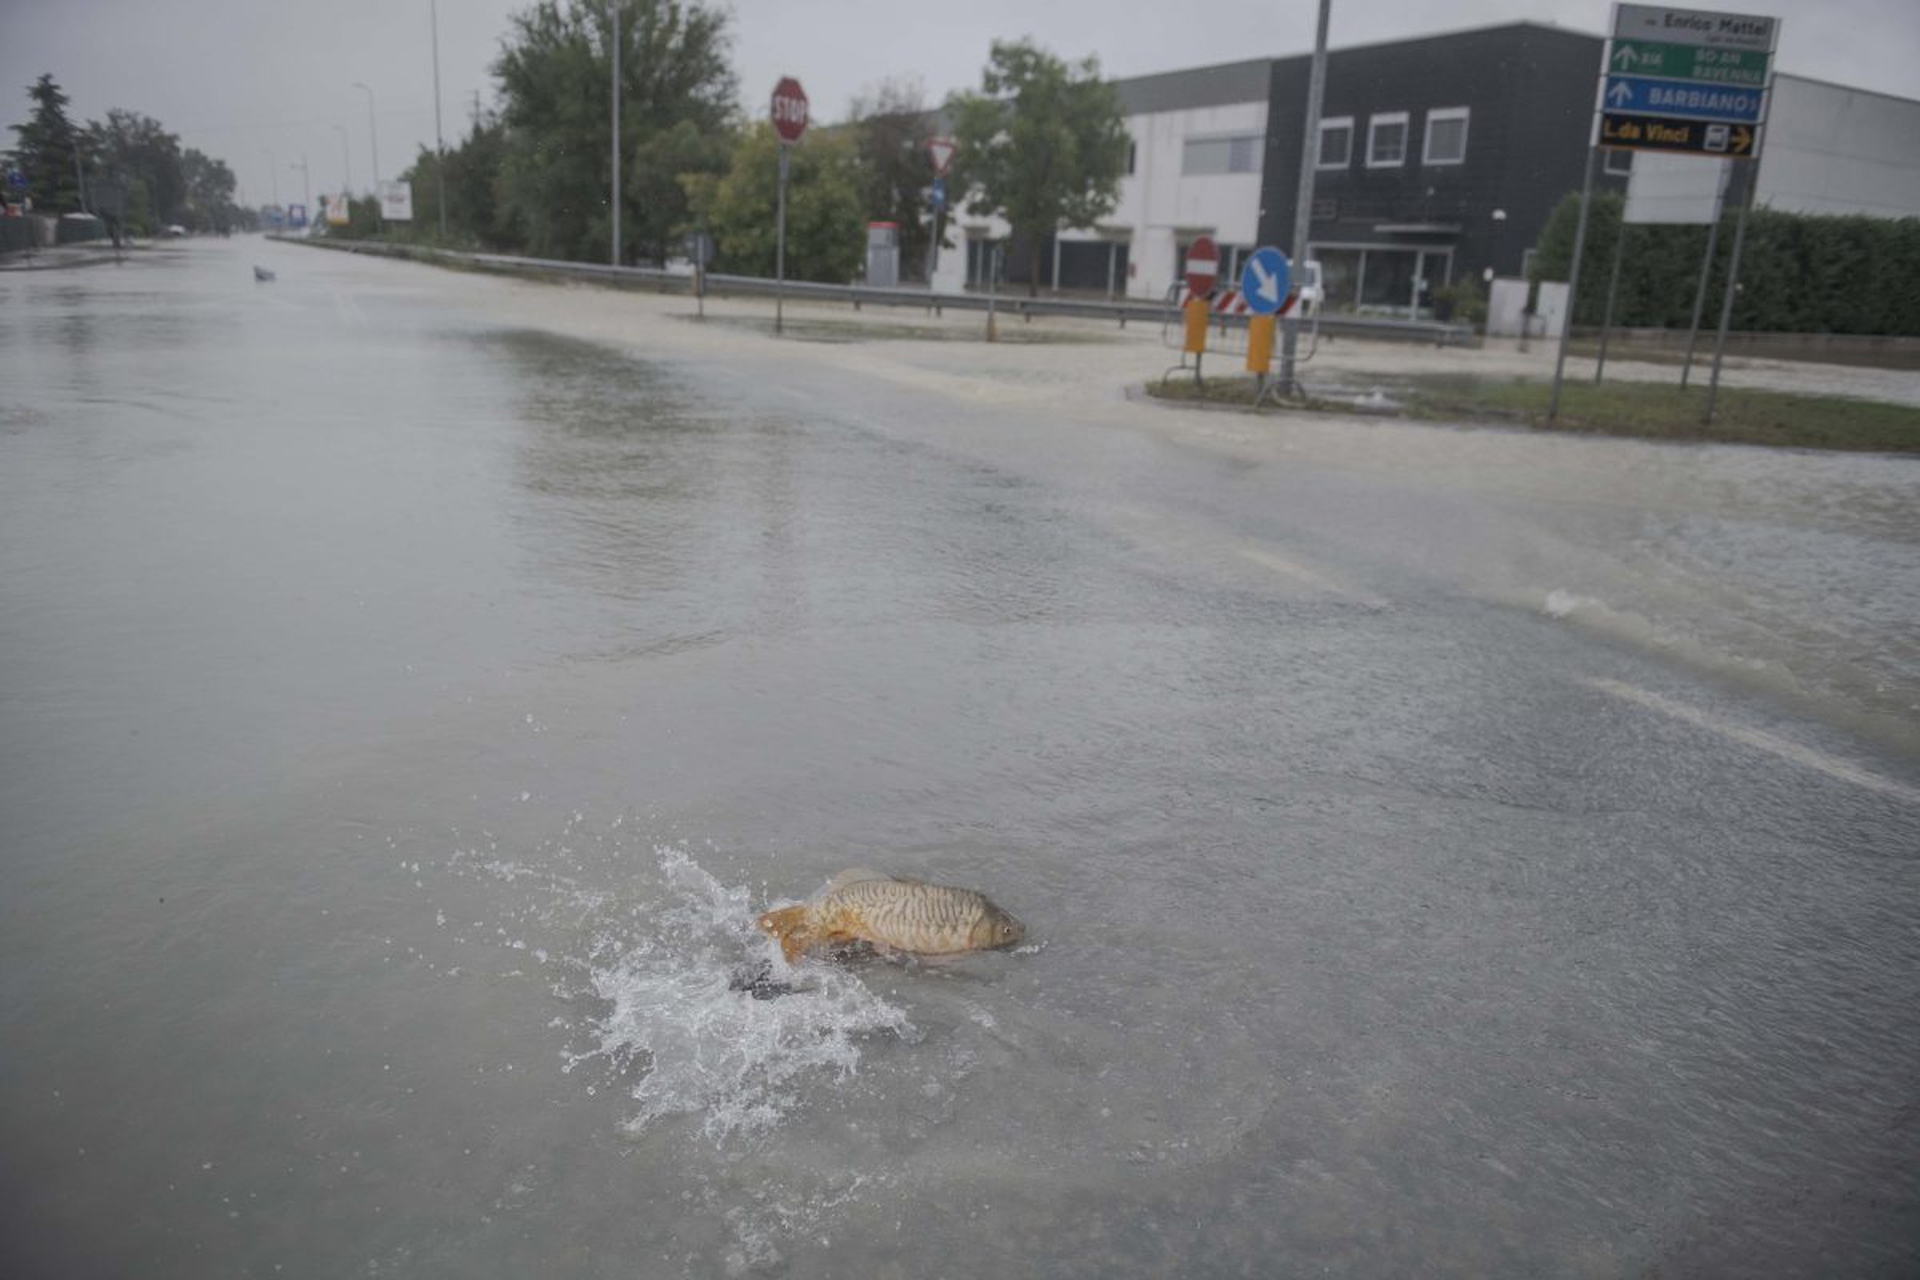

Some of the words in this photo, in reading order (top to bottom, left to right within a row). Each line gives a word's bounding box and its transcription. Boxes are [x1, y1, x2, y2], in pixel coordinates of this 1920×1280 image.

[1664, 13, 1712, 31] Enrico
[774, 96, 806, 123] STOP
[1648, 87, 1748, 112] BARBIANO
[1645, 122, 1691, 143] Vinci
